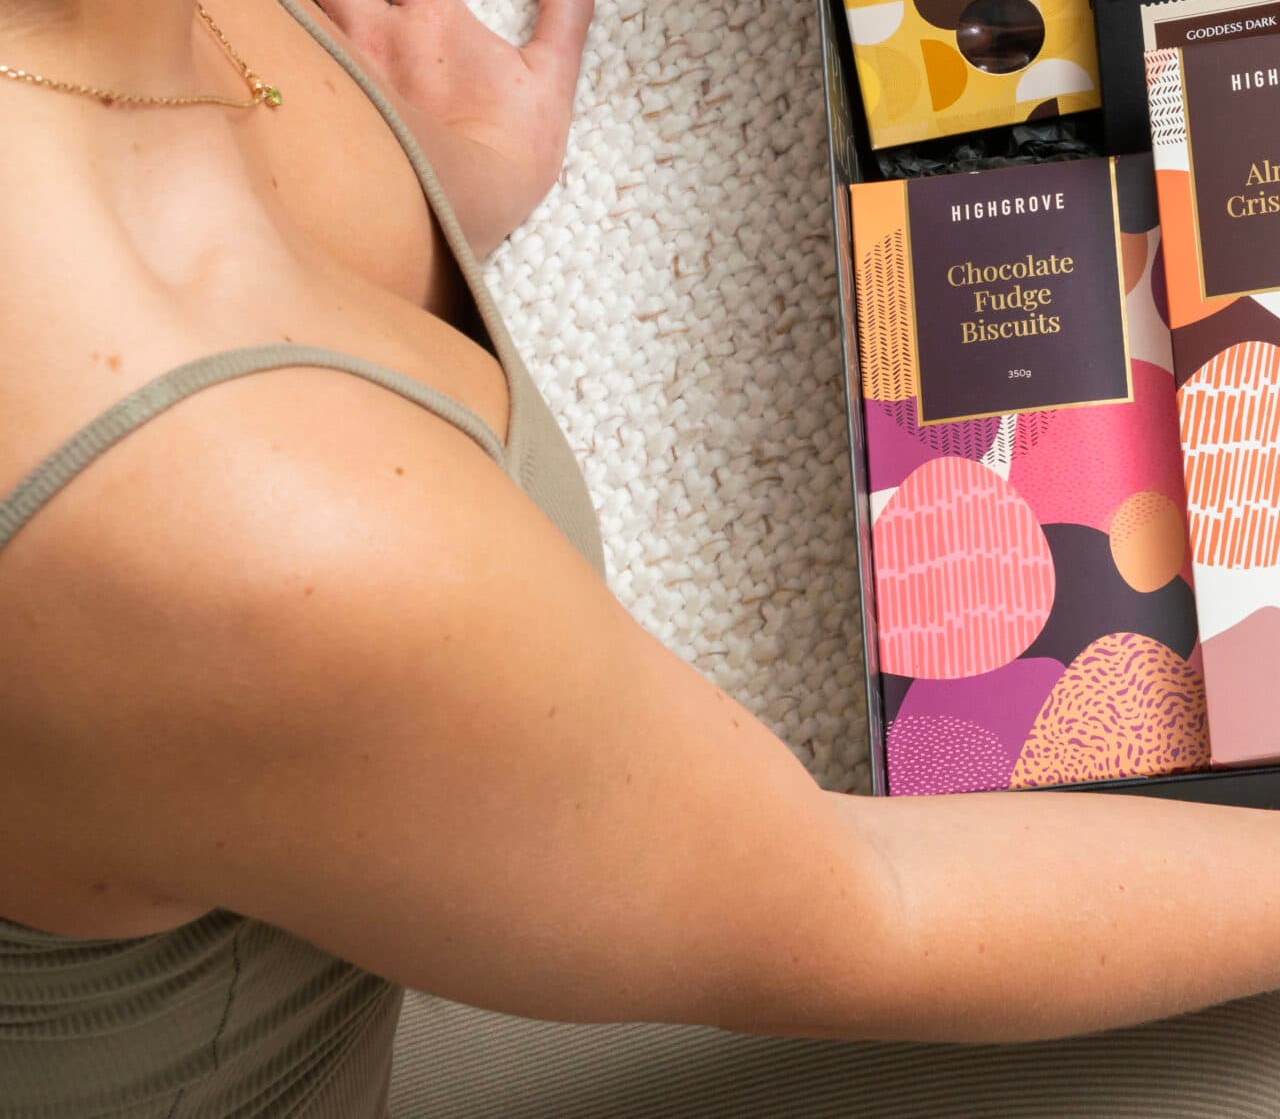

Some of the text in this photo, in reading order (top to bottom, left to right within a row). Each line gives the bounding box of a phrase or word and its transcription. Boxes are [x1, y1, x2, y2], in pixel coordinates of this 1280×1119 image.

[1186, 16, 1278, 41] GODDESS DARK
[951, 193, 1066, 222] HIGHGROVE
[947, 254, 1074, 287] Chocolate
[973, 285, 1052, 313] Fudge
[960, 312, 1061, 344] Biscuits
[1008, 369, 1032, 379] 350g
